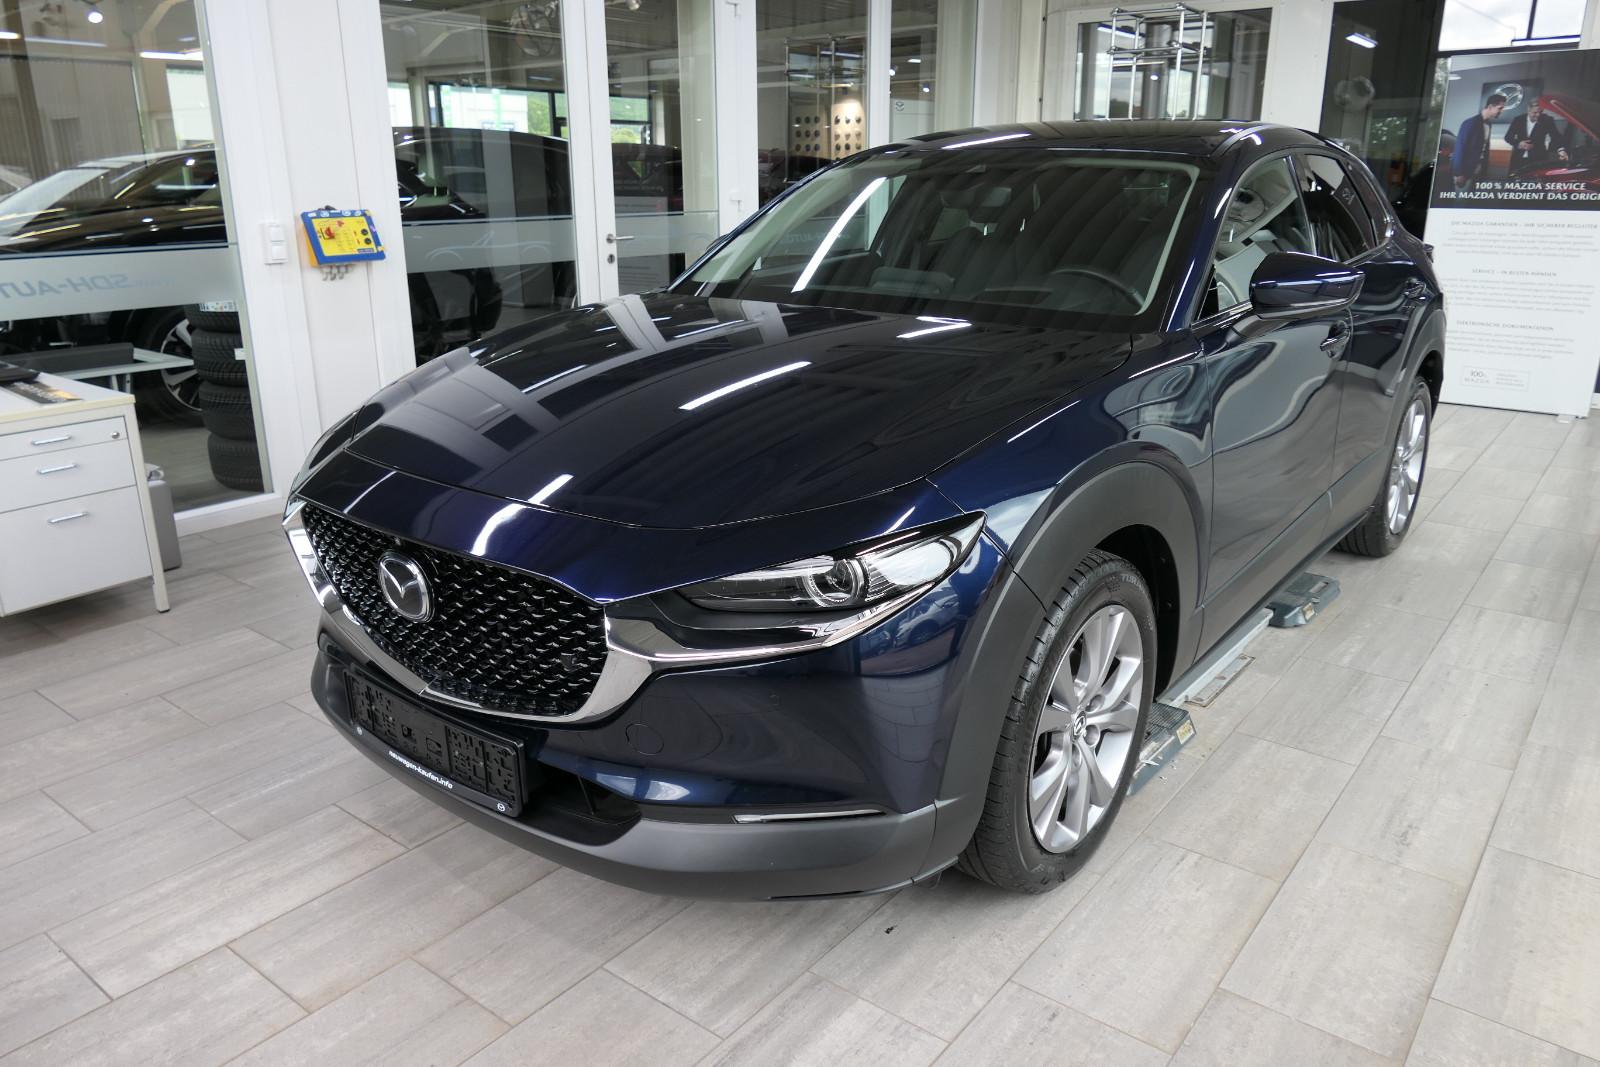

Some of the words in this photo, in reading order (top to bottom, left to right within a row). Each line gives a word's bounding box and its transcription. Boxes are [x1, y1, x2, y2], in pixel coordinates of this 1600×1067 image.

[1475, 182, 1493, 190] 100
[1504, 182, 1542, 190] MAZDA
[1545, 182, 1587, 191] SERVICE
[1439, 191, 1457, 199] IHR
[1458, 191, 1495, 200] MAZDA
[1497, 192, 1545, 200] VERDIENT
[1547, 192, 1568, 201] DAS
[389, 750, 453, 789] neuwagen-kaufen.info
